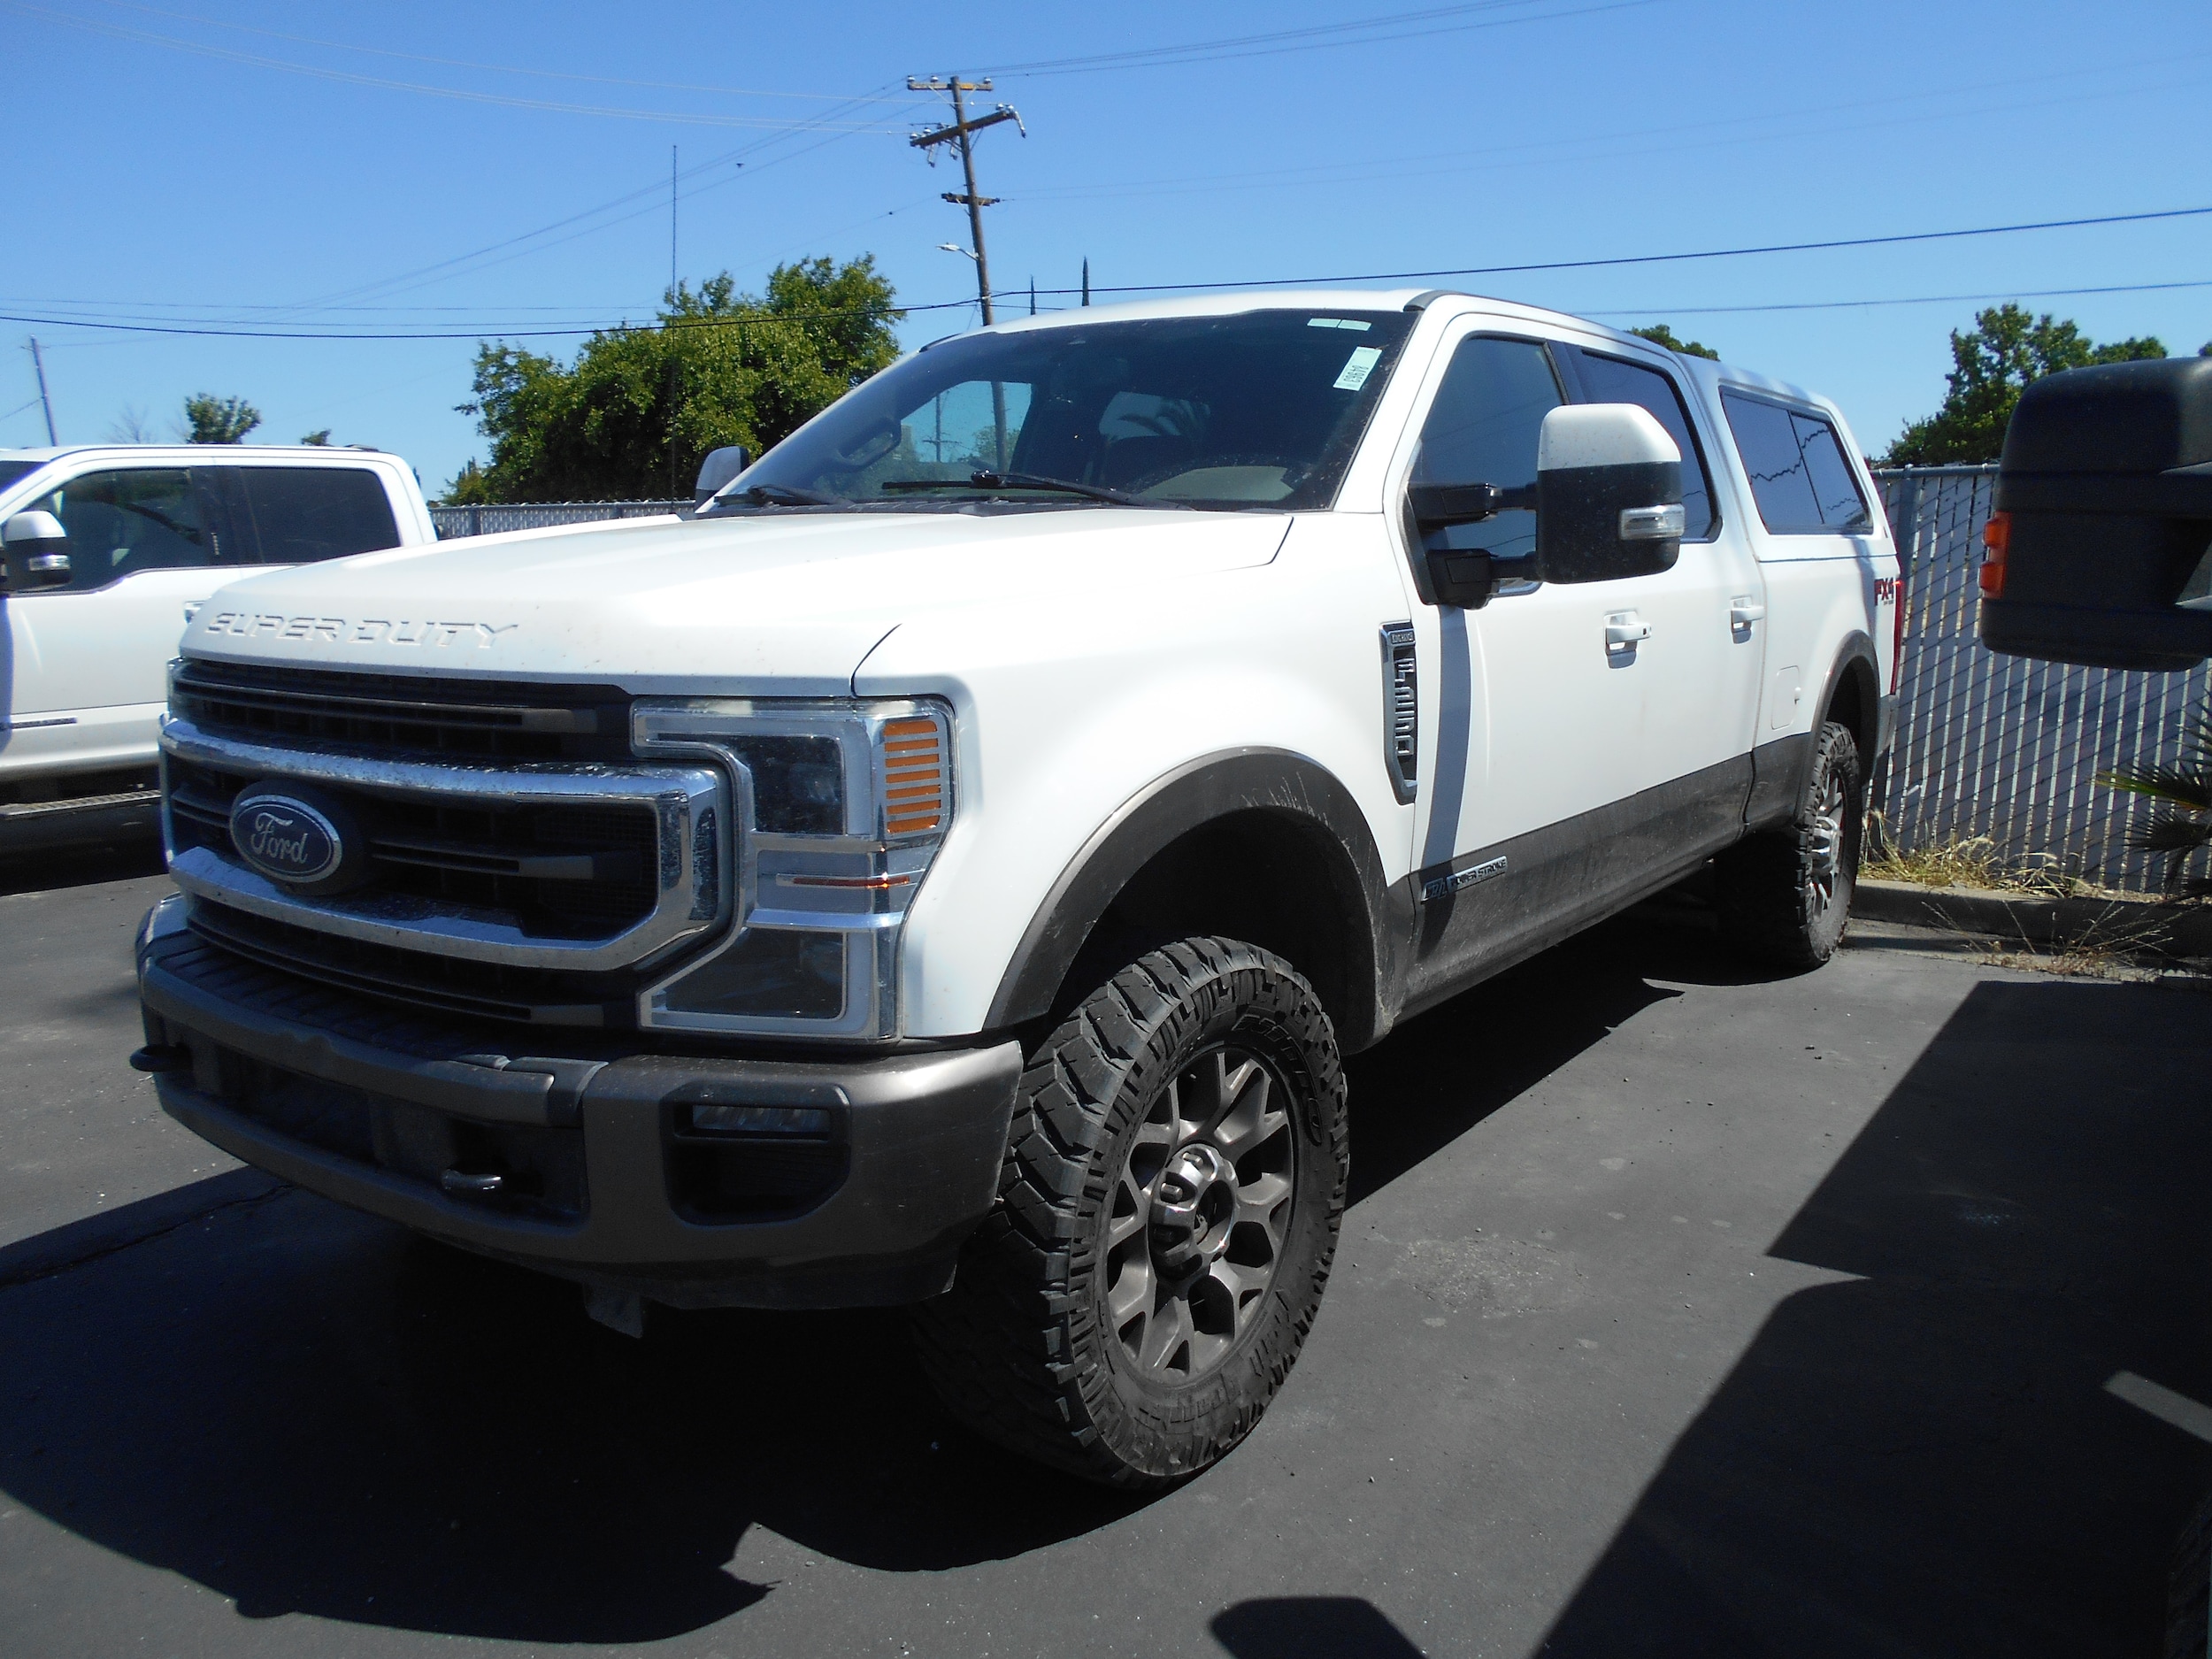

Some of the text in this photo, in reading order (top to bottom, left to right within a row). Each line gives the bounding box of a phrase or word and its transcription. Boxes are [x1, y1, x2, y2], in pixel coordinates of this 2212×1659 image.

[204, 612, 519, 649] SUPER DUTY
[250, 811, 309, 864] Ford
